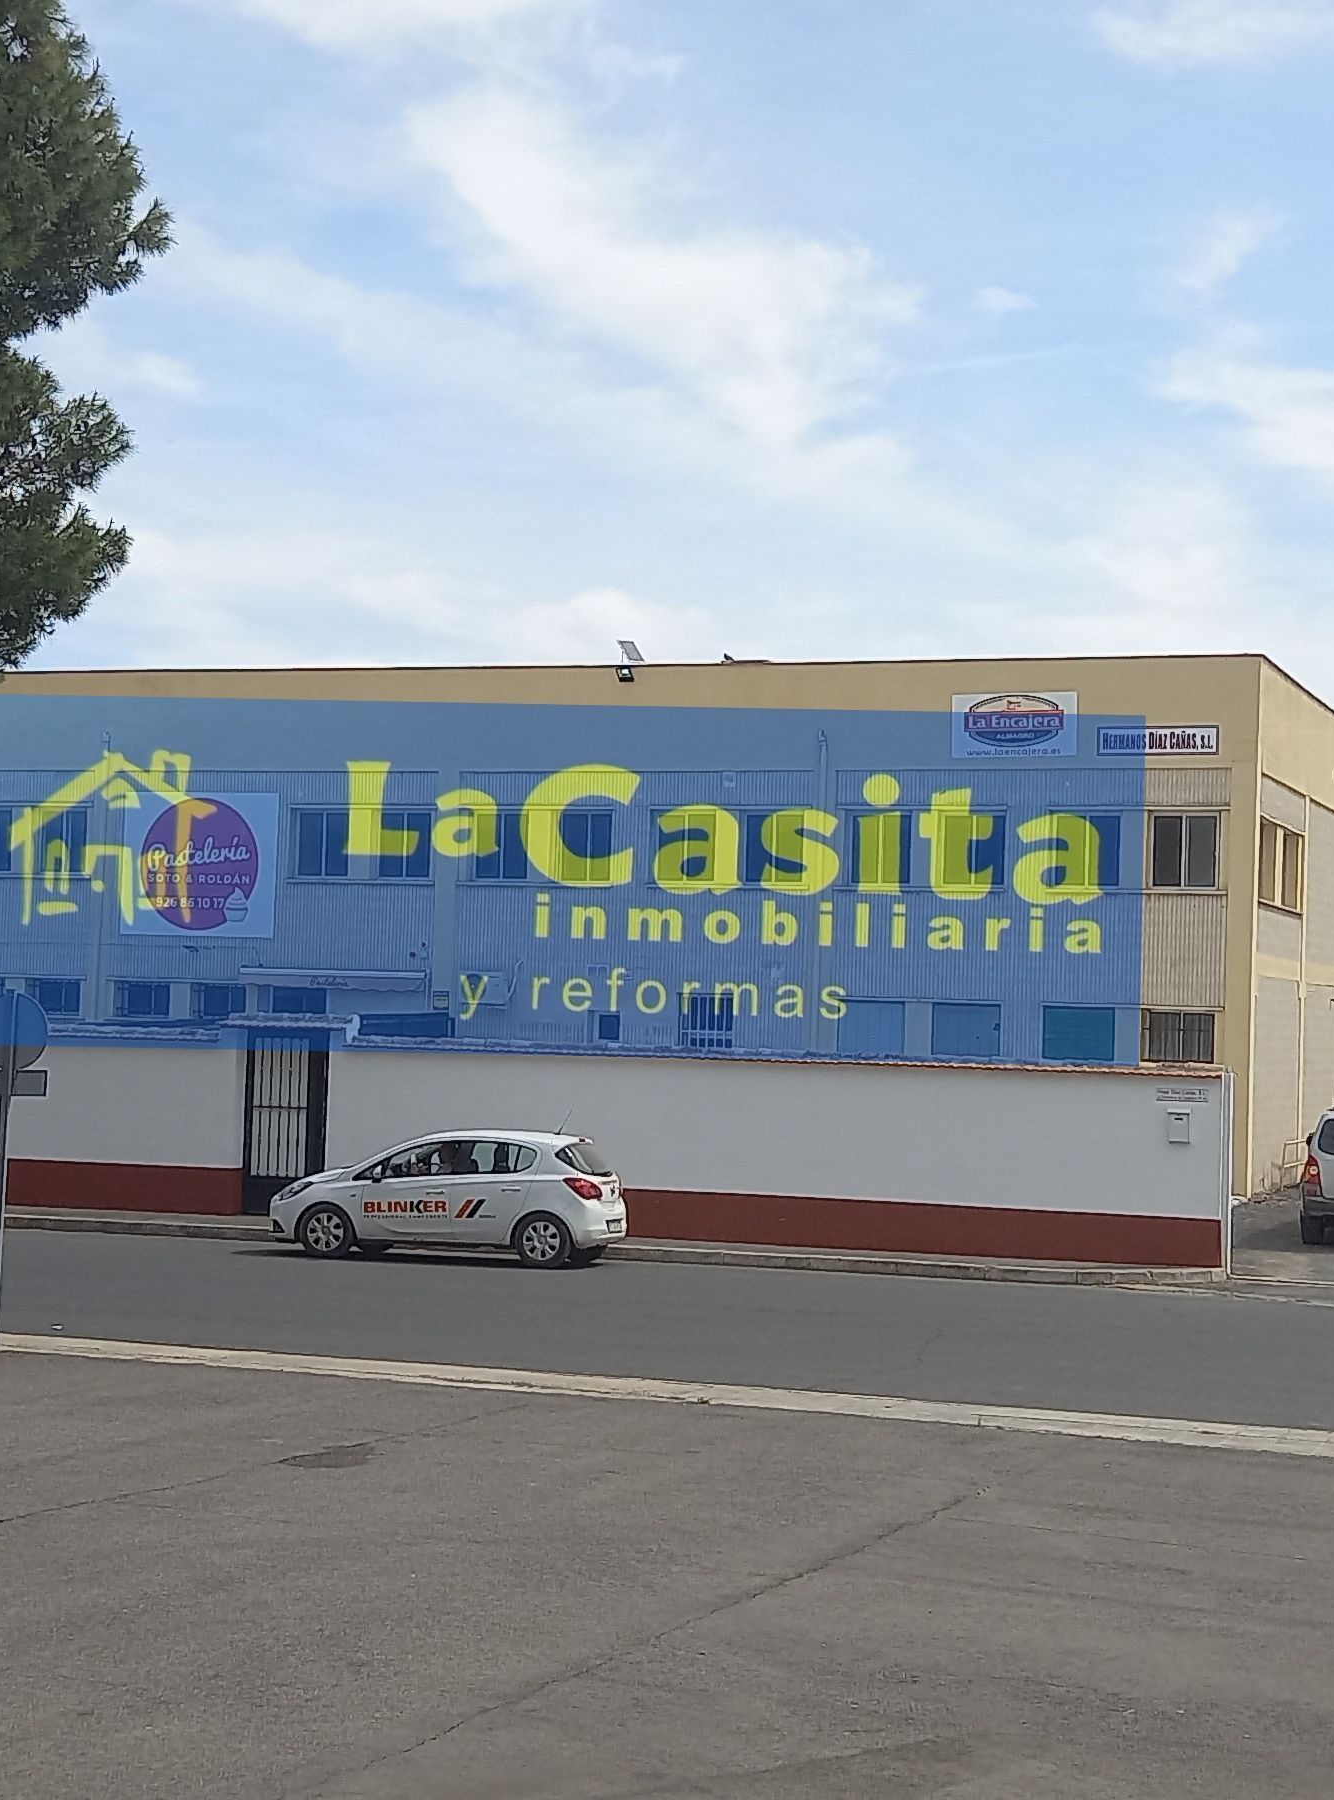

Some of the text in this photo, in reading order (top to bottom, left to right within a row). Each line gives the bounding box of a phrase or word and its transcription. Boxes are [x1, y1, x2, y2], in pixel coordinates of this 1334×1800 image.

[968, 713, 1061, 731] La Encajera
[1102, 732, 1146, 750] HERMANOS
[1149, 731, 1167, 750] DÍAZ
[967, 747, 1061, 757] www.laencajera.es
[147, 836, 251, 871] Pastelería
[148, 873, 180, 883] SOTO
[199, 872, 250, 884] ROLDÁN
[156, 896, 178, 908] 926
[363, 1199, 447, 1214] BLINKER
